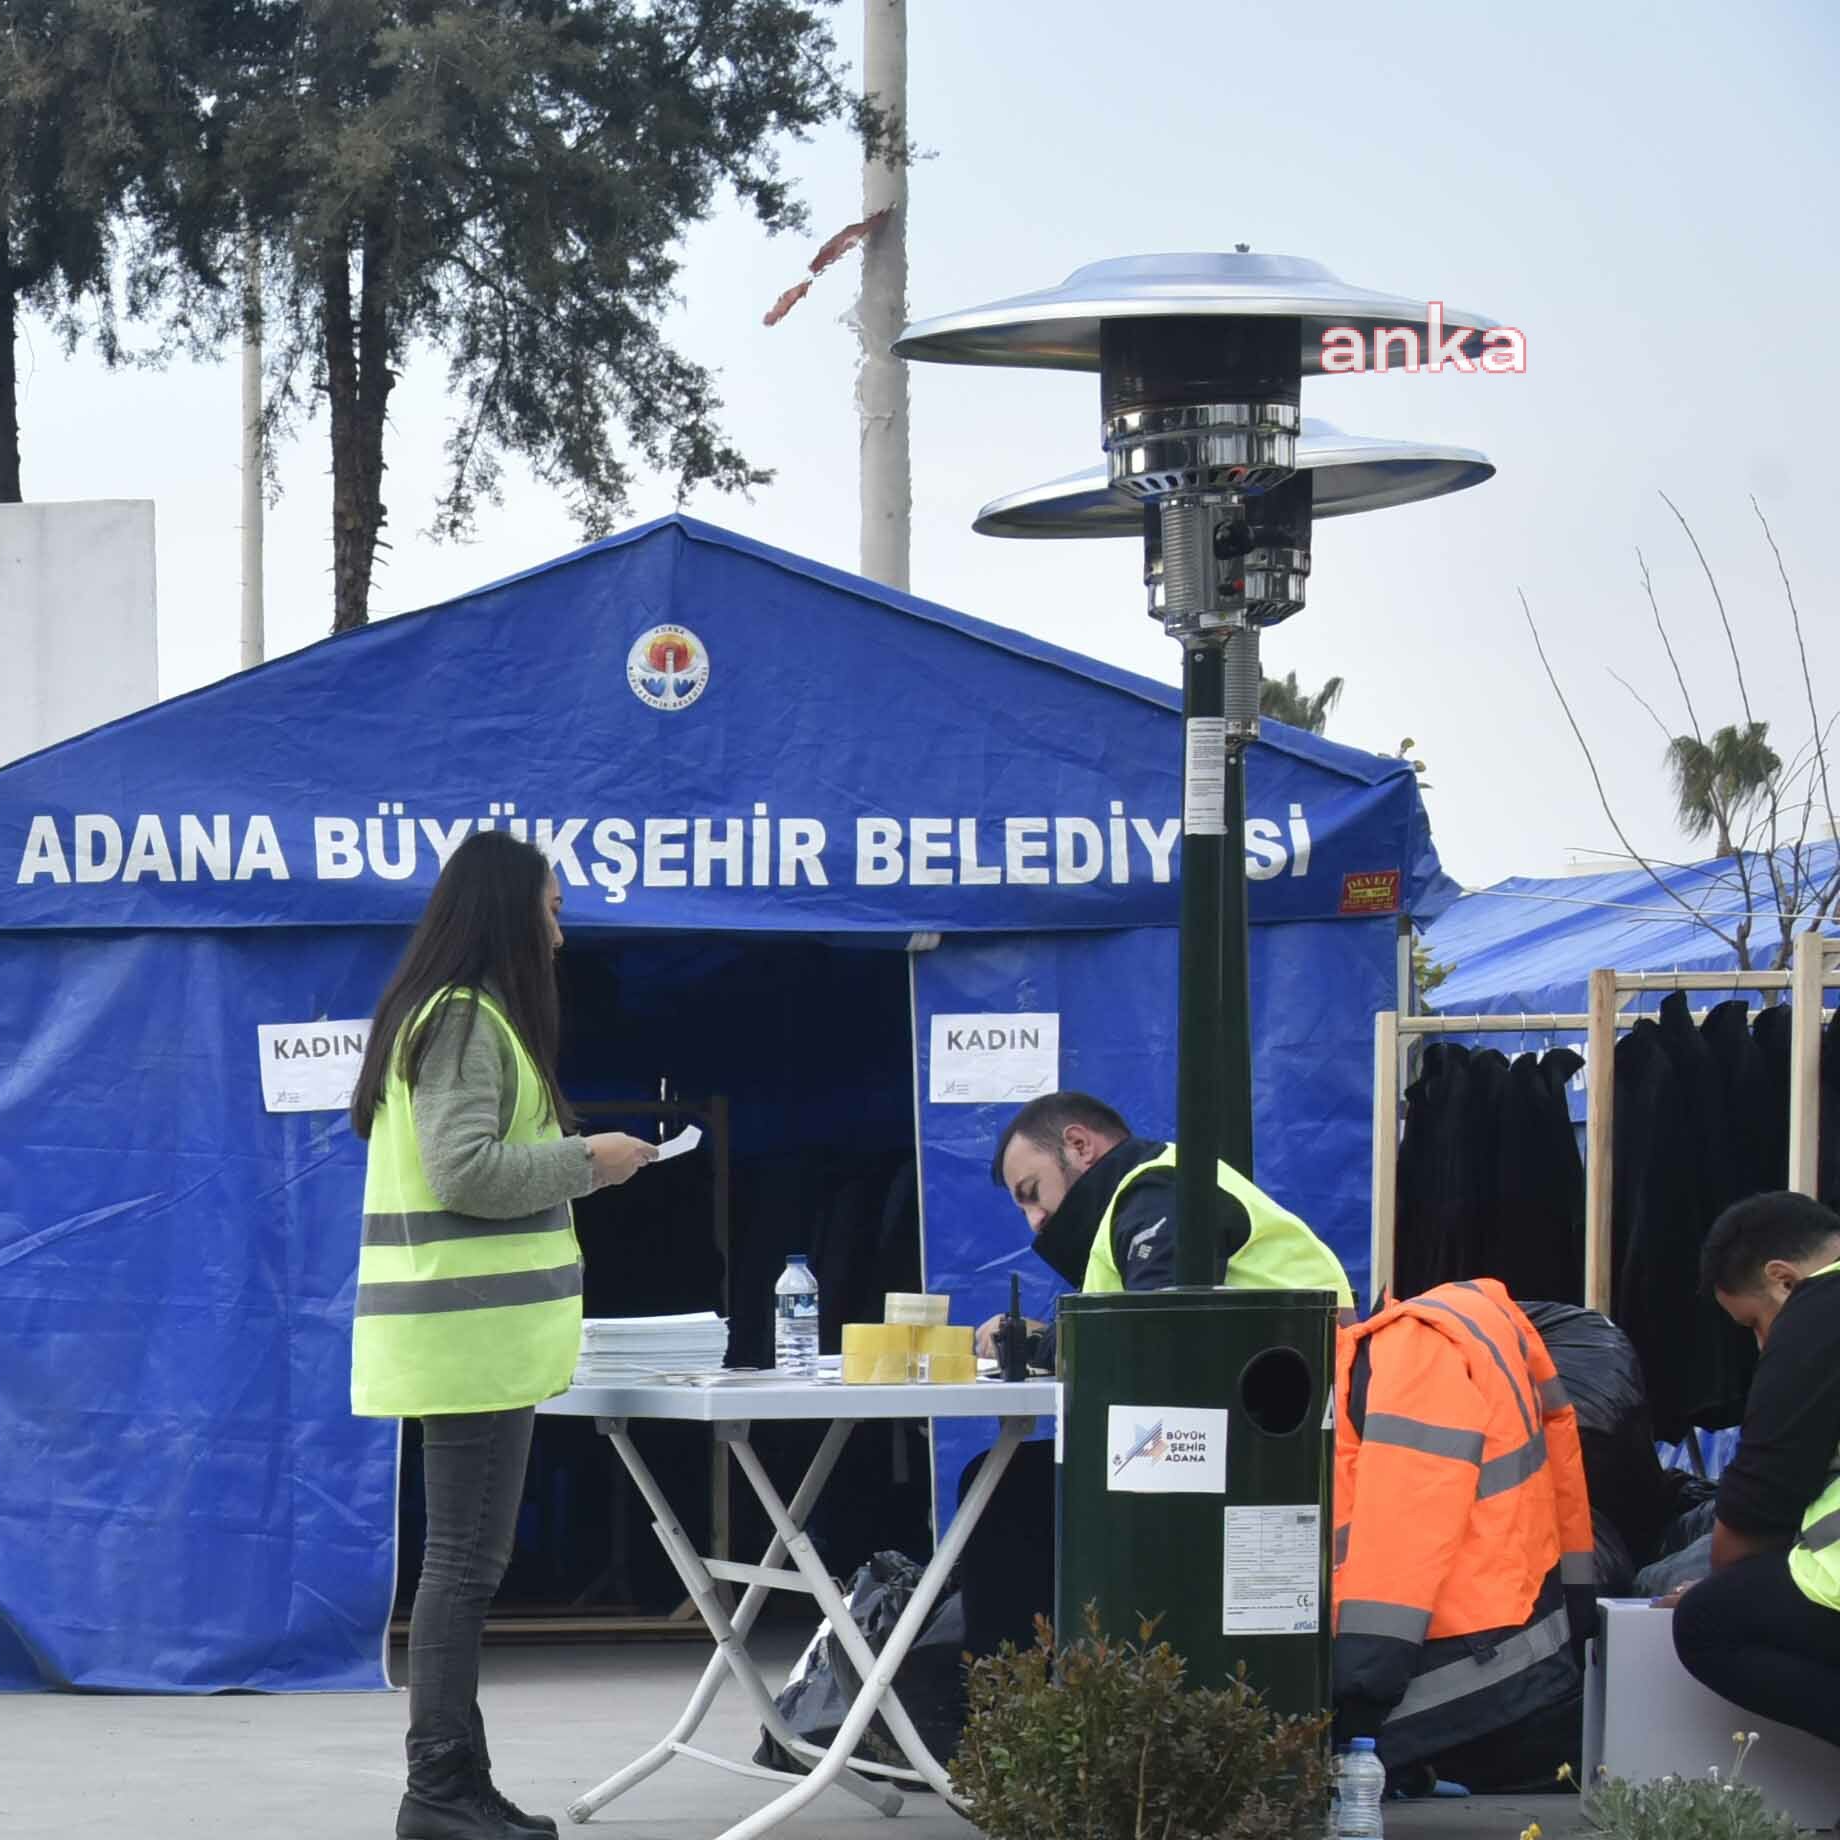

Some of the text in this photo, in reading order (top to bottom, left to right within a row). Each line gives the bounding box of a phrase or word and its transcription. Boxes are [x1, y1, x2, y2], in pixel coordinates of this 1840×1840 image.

[17, 801, 1312, 903] ADANA BÜYKŞEHİR BELEDİYSİ
[273, 1033, 364, 1060] KADIN
[946, 1028, 1040, 1051] KADIN
[1166, 1430, 1207, 1441] BÜYÜK
[1170, 1442, 1207, 1454] ŞEHİR
[1165, 1454, 1207, 1463] ADANA
